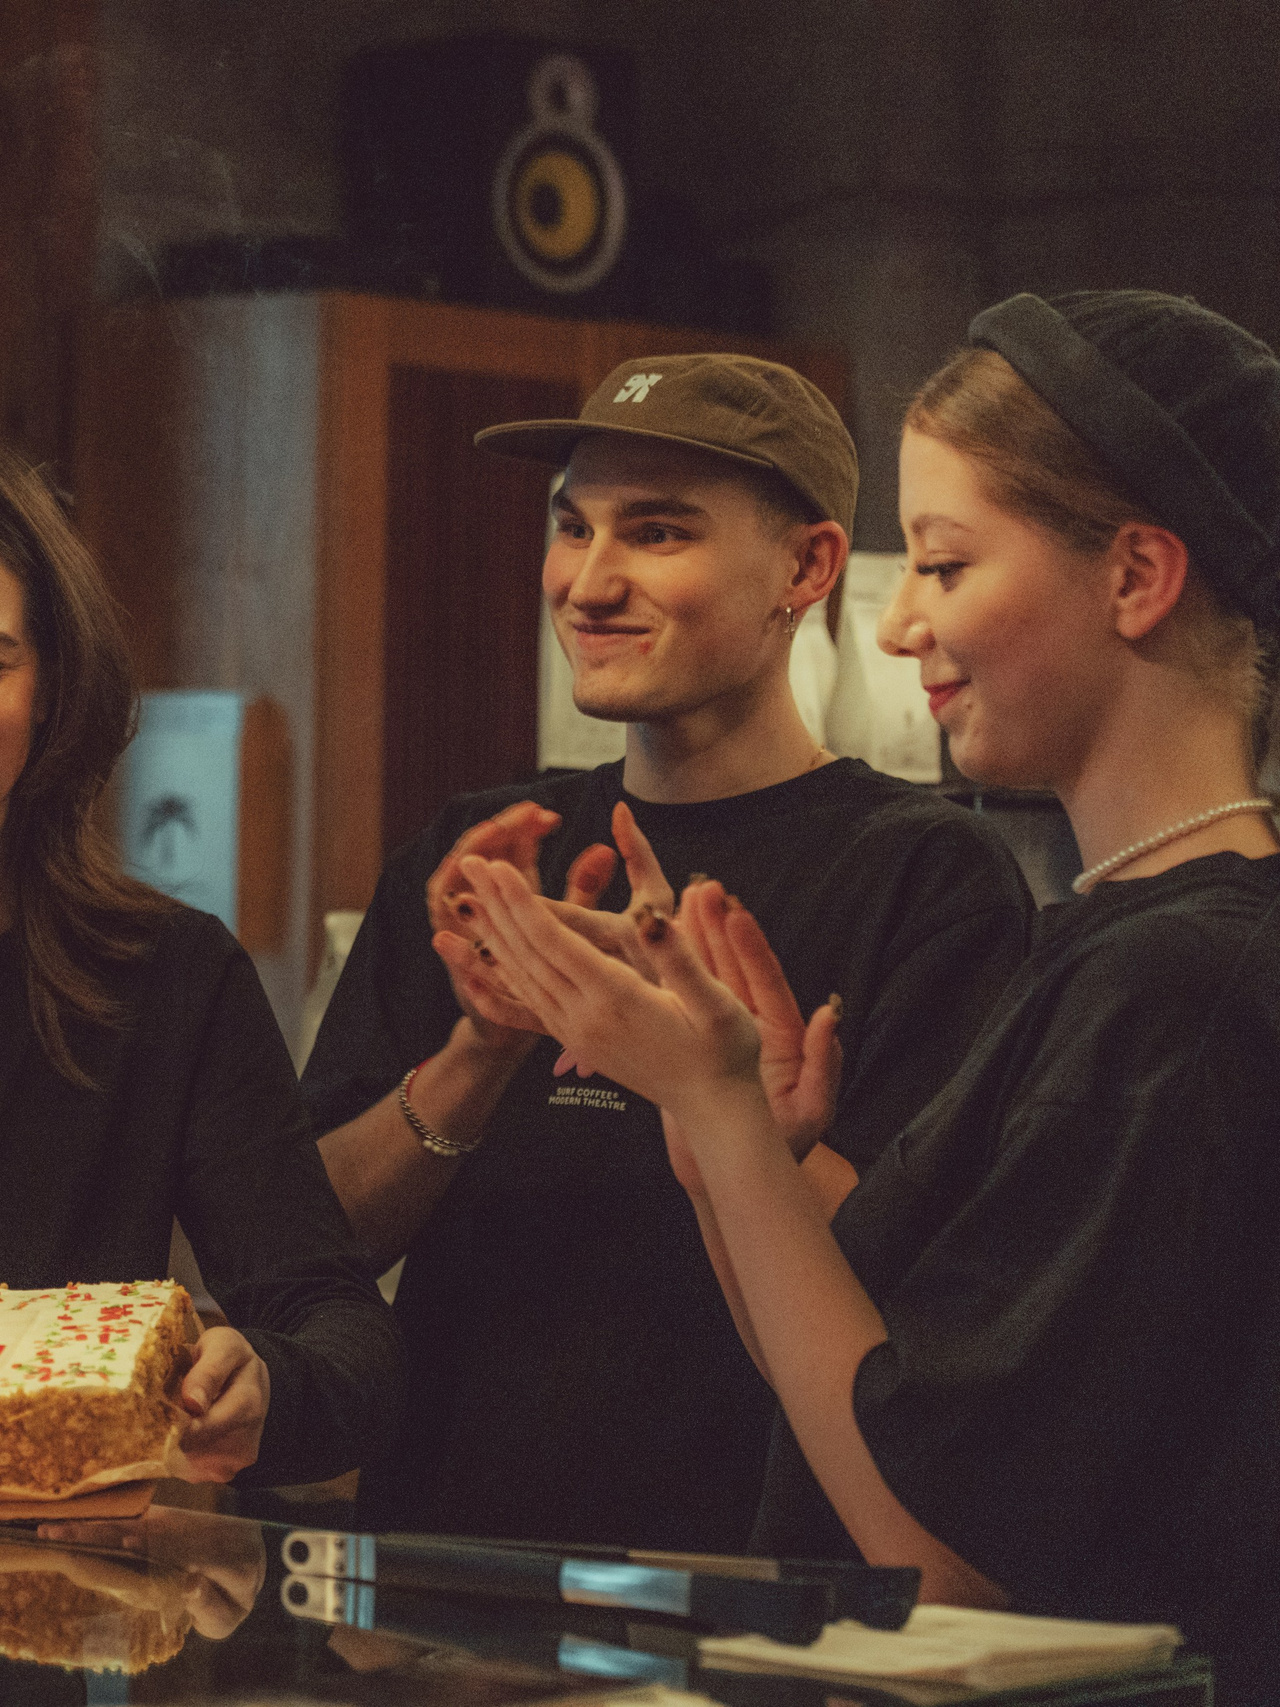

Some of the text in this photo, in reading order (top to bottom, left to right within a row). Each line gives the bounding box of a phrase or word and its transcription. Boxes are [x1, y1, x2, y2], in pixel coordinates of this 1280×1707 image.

[557, 1087, 576, 1095] SURF
[548, 1095, 626, 1110] MODERN THEATRE
